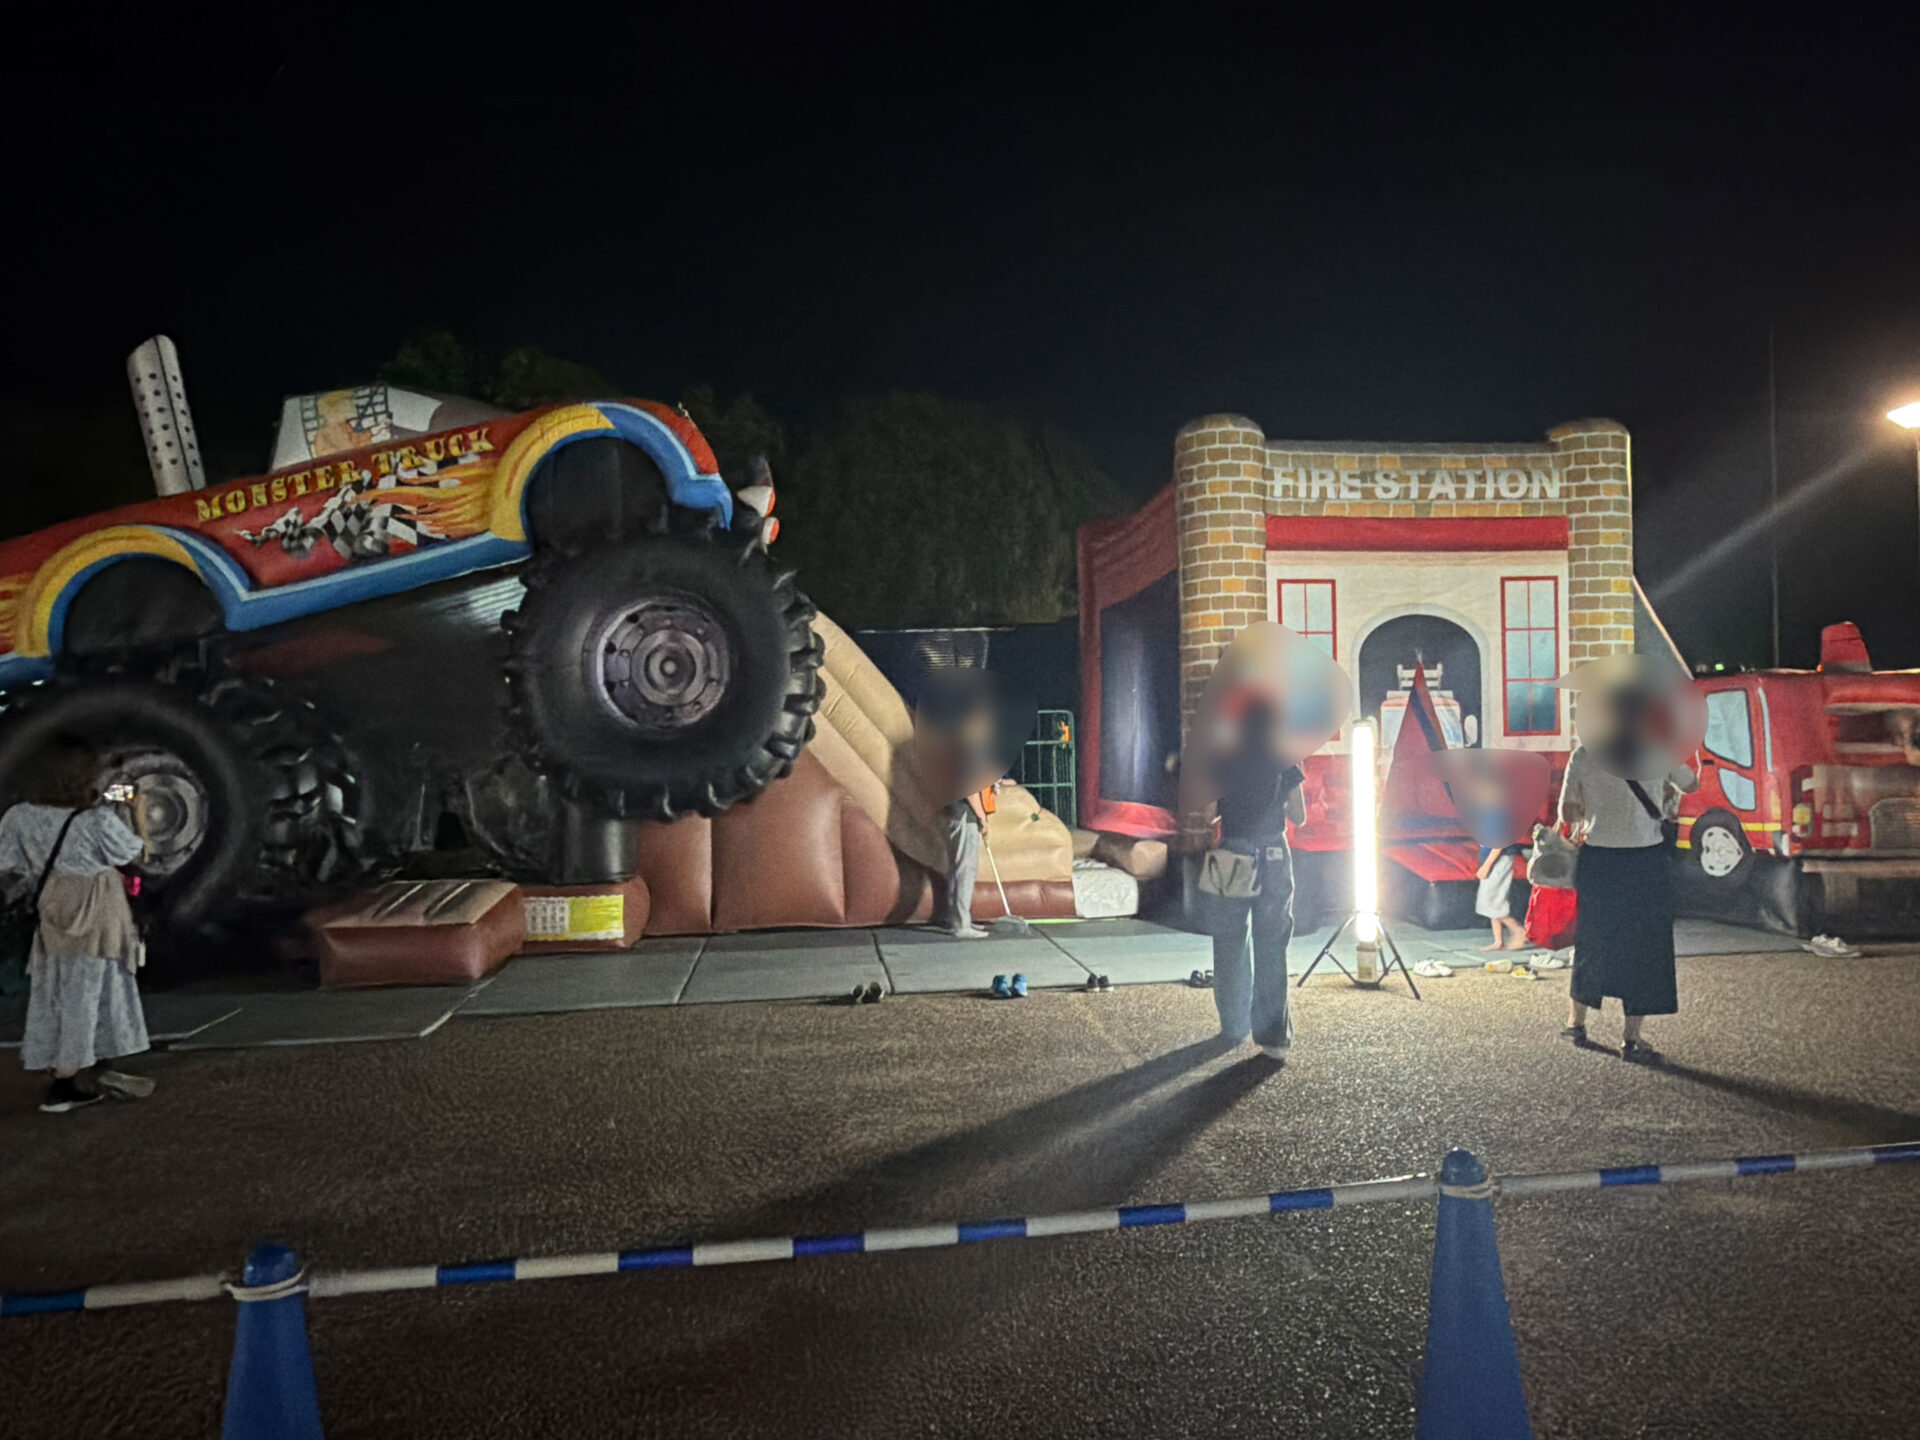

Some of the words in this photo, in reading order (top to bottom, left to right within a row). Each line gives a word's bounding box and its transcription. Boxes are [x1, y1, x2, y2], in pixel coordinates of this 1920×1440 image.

[196, 460, 361, 522] MONSTER
[371, 428, 494, 475] TRUCK
[1273, 467, 1361, 499] FIRE
[1374, 468, 1560, 499] STATION
